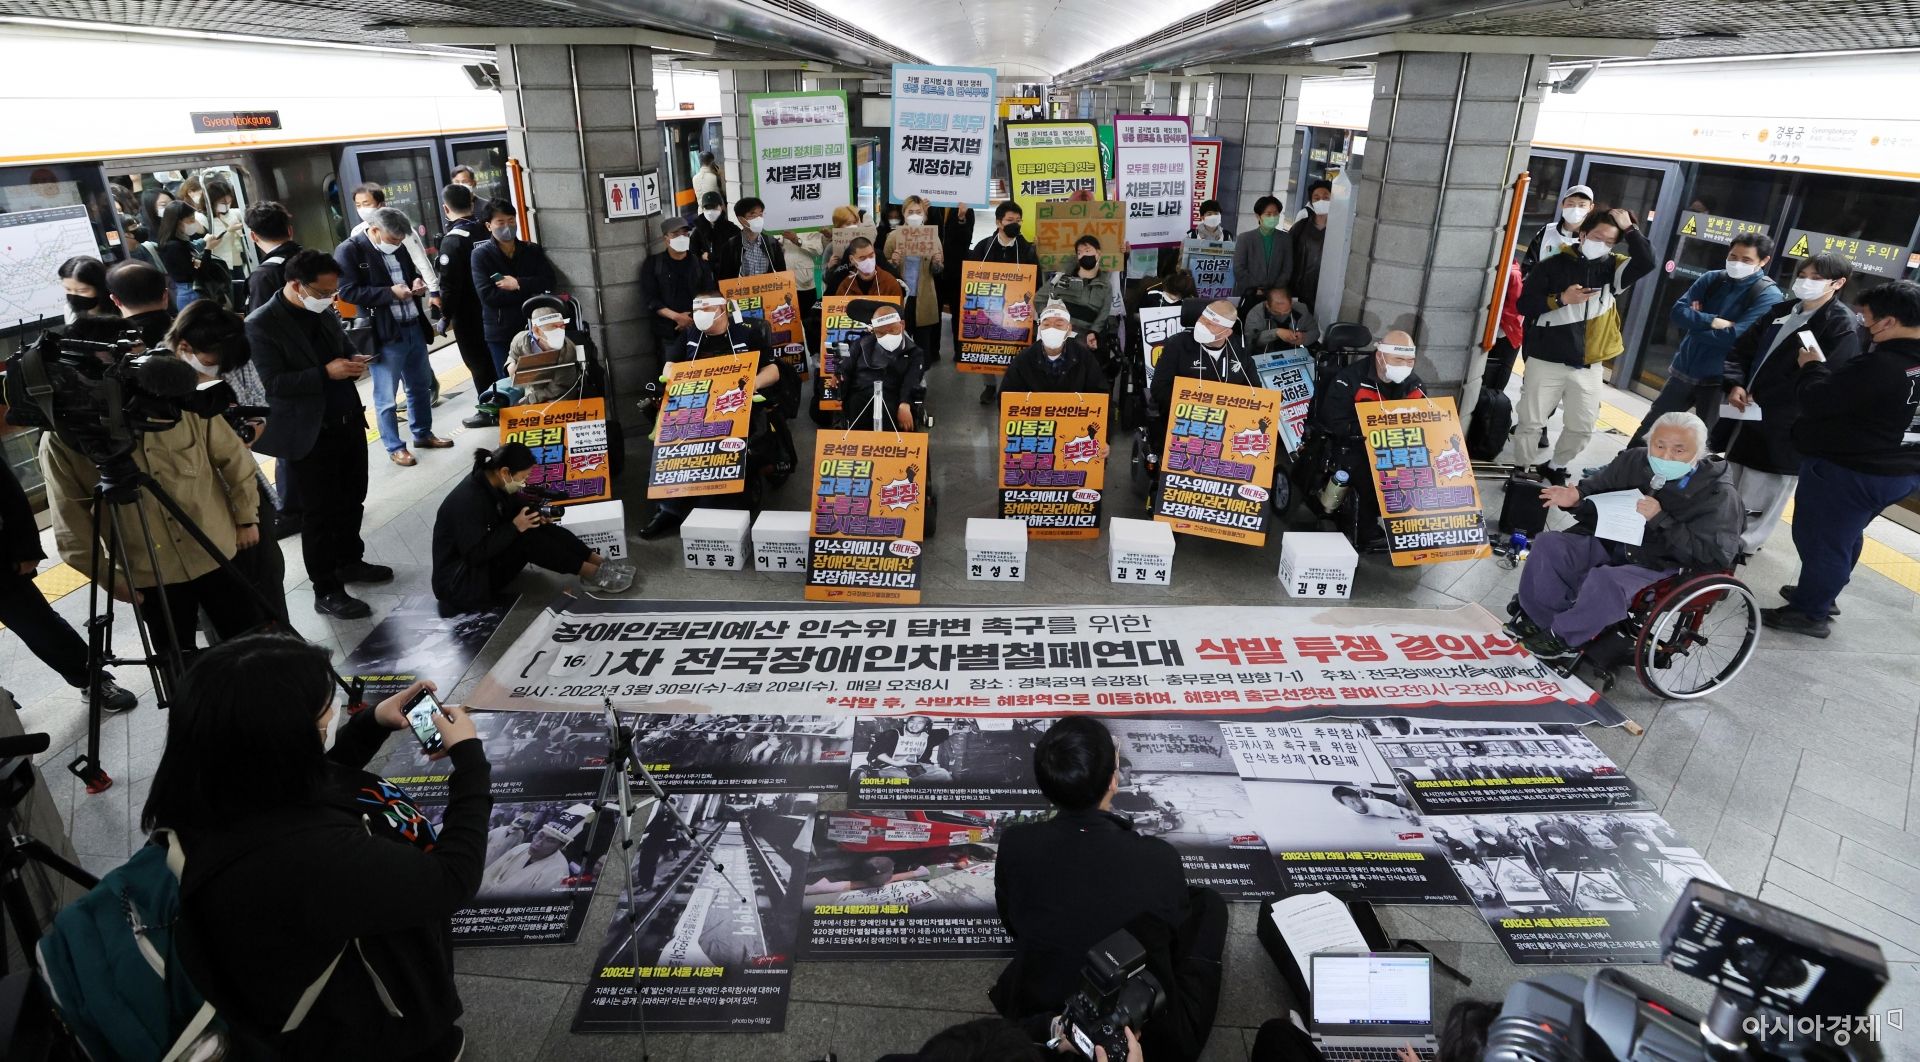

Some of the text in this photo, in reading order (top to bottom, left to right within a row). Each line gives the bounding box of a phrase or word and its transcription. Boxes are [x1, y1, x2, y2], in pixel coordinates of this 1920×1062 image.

[203, 115, 271, 127] Gyeongbokgung
[1775, 125, 1805, 140] 경복궁
[762, 147, 792, 160] 차별의
[901, 135, 982, 155] 차별금지법
[766, 161, 841, 183] 차별금지법
[908, 158, 972, 177] 제정하라
[1047, 162, 1075, 173] 약속을
[1126, 163, 1184, 174] 모두를 위한 내일
[790, 183, 821, 200] 제정
[1021, 178, 1096, 196] 차별금지법
[1125, 181, 1185, 198] 차별금지법
[1039, 206, 1054, 219] 더
[1130, 201, 1182, 218] 있는 나라
[1707, 217, 1762, 233] 발빠짐 주의!
[1824, 237, 1900, 261] 발빠짐 주의!
[1195, 259, 1231, 272] 지하철
[967, 270, 990, 281] 윤석열
[1197, 273, 1225, 284] 1역사
[726, 286, 750, 298] 윤석열
[964, 281, 1006, 297] 이동권
[673, 369, 703, 381] 윤석열
[1272, 368, 1303, 388] 수도권
[668, 379, 713, 397] 이동권
[1179, 389, 1214, 403] 윤석열
[664, 393, 709, 411] 교육권
[714, 390, 747, 412] 보장
[661, 408, 707, 427] 노동권
[1008, 405, 1042, 417] 윤석열
[1174, 403, 1228, 424] 이동권
[1366, 412, 1398, 427] 윤석열
[660, 420, 734, 443] 탈시설권리
[1005, 419, 1057, 437] 이동권
[1170, 417, 1226, 441] 교육권
[1004, 436, 1056, 454] 교육권
[1168, 435, 1224, 459] 노동권
[1232, 433, 1270, 452] 보장
[1369, 427, 1426, 449] 이동권
[657, 442, 716, 459] 인수위에서
[822, 443, 859, 457] 윤석열
[1064, 439, 1099, 460] 보장
[655, 451, 740, 472] 장애인권리예산
[1004, 452, 1056, 470] 노동권
[1167, 451, 1256, 482] 탈시설권리
[1374, 447, 1431, 471] 교육권
[653, 465, 741, 485] 보장해주십시오!
[819, 459, 874, 478] 이동권
[816, 477, 872, 496] 교육권
[1004, 469, 1087, 487] 탈시설권리
[1165, 474, 1235, 497] 인수위에서
[1378, 467, 1436, 491] 노동권
[880, 482, 919, 506] 보장
[1004, 490, 1069, 503] 인수위에서
[1162, 487, 1262, 516] 장애인권리예산
[1383, 485, 1475, 513] 탈시설권리
[815, 496, 871, 515] 노동권
[1003, 502, 1095, 515] 장애인권리예산
[1160, 501, 1263, 531] 보장해주십시오!
[1390, 513, 1478, 535] 장애인권리예산
[815, 514, 906, 537] 탈시설권리
[814, 539, 886, 556] 인수위에서
[1394, 528, 1485, 550] 보장해주십시오!
[891, 543, 919, 555] 제대로
[757, 555, 807, 570] 이규식
[813, 554, 914, 572] 장애인권리예산
[811, 569, 916, 588] 보장해주십시오!
[552, 614, 1152, 643] 장애인권리예산 인수위 답변 촉구를 위한
[672, 633, 1533, 676] 전국장애인차별철폐연대 삭발 투쟁 결의식
[559, 684, 619, 698] 2022년
[621, 683, 652, 696] 3월
[655, 681, 763, 695] 30일(수)-4월
[846, 680, 883, 692] 매일
[885, 678, 950, 692] 오전8시
[1017, 675, 1087, 690] 경복궁역
[1237, 672, 1272, 685] 방향
[915, 695, 990, 708] 삭발자는
[997, 694, 1091, 708] 혜화역으로
[1184, 689, 1241, 705] 혜화역
[1245, 687, 1337, 702] 출근선전전
[1222, 727, 1368, 740] 리프트 장애인 추락참사
[1228, 739, 1275, 750] 공개사과
[1283, 740, 1322, 753] 촉구를
[1331, 742, 1358, 754] 위한
[1242, 752, 1360, 767] 단식농성제 18일째
[814, 904, 909, 915] 2021년 세종시
[813, 919, 857, 927] 정부에서 정한
[917, 927, 992, 935] 세종시에서 이날
[811, 936, 833, 945] 세종시
[870, 936, 899, 945] 장애인이
[917, 936, 932, 944] 없는
[943, 936, 964, 944] 버스를
[599, 966, 693, 979] 2002년 서울
[594, 986, 781, 995] 지하철 장애인 추락참사에 대하여
[591, 996, 718, 1006] 서울시는 현수막이
